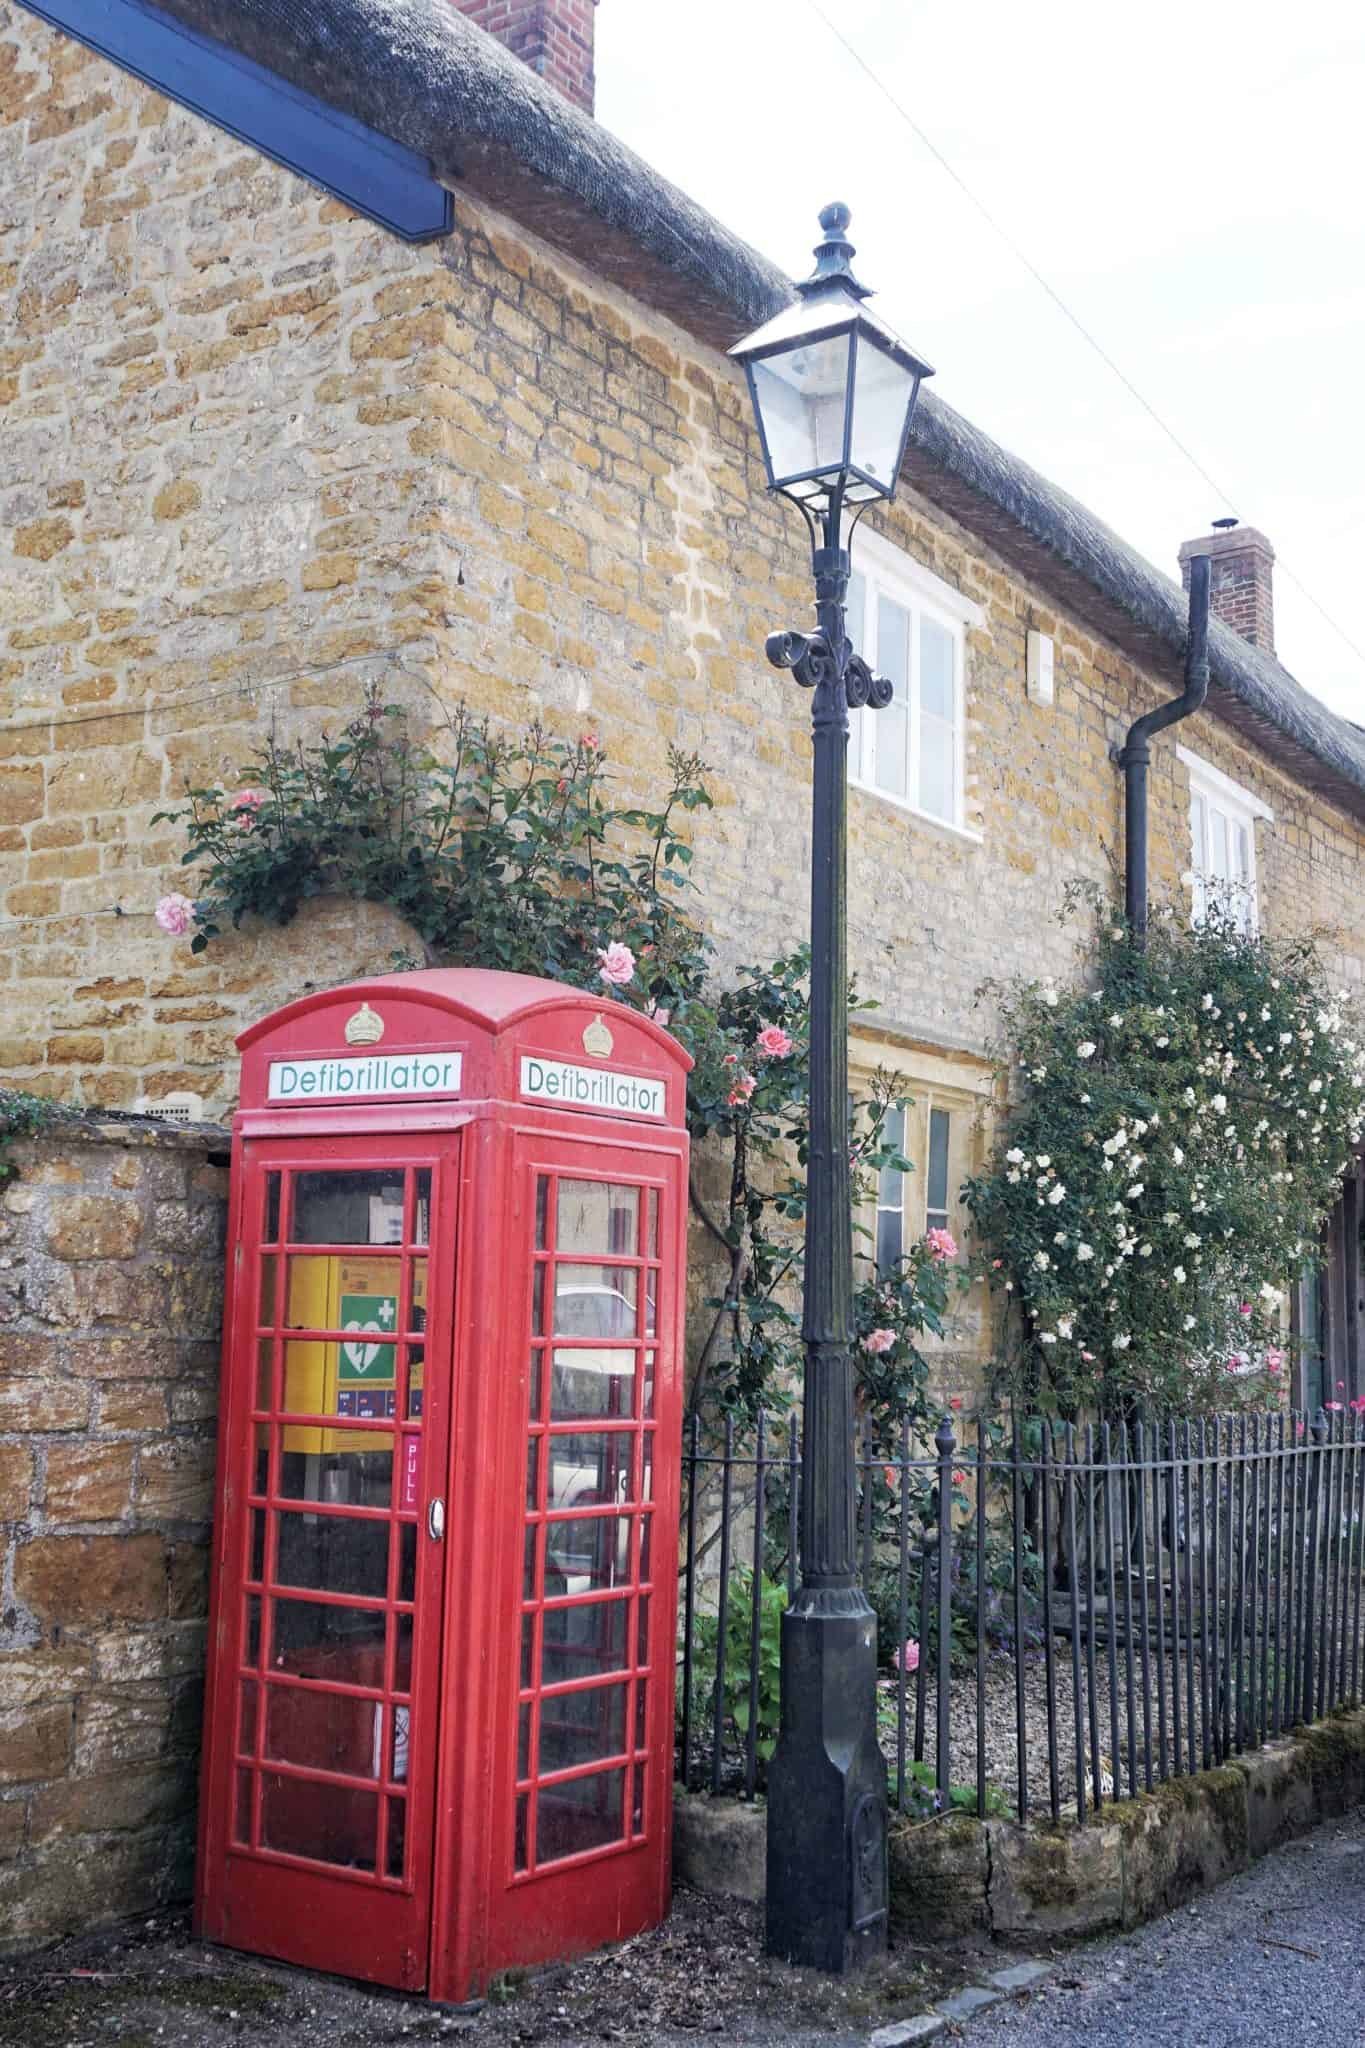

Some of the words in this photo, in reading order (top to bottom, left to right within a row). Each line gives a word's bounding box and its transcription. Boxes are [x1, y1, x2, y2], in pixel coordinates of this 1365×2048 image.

[280, 1058, 452, 1094] Defibrillator
[528, 1062, 658, 1112] Defibrillator
[407, 1444, 417, 1502] PULL
